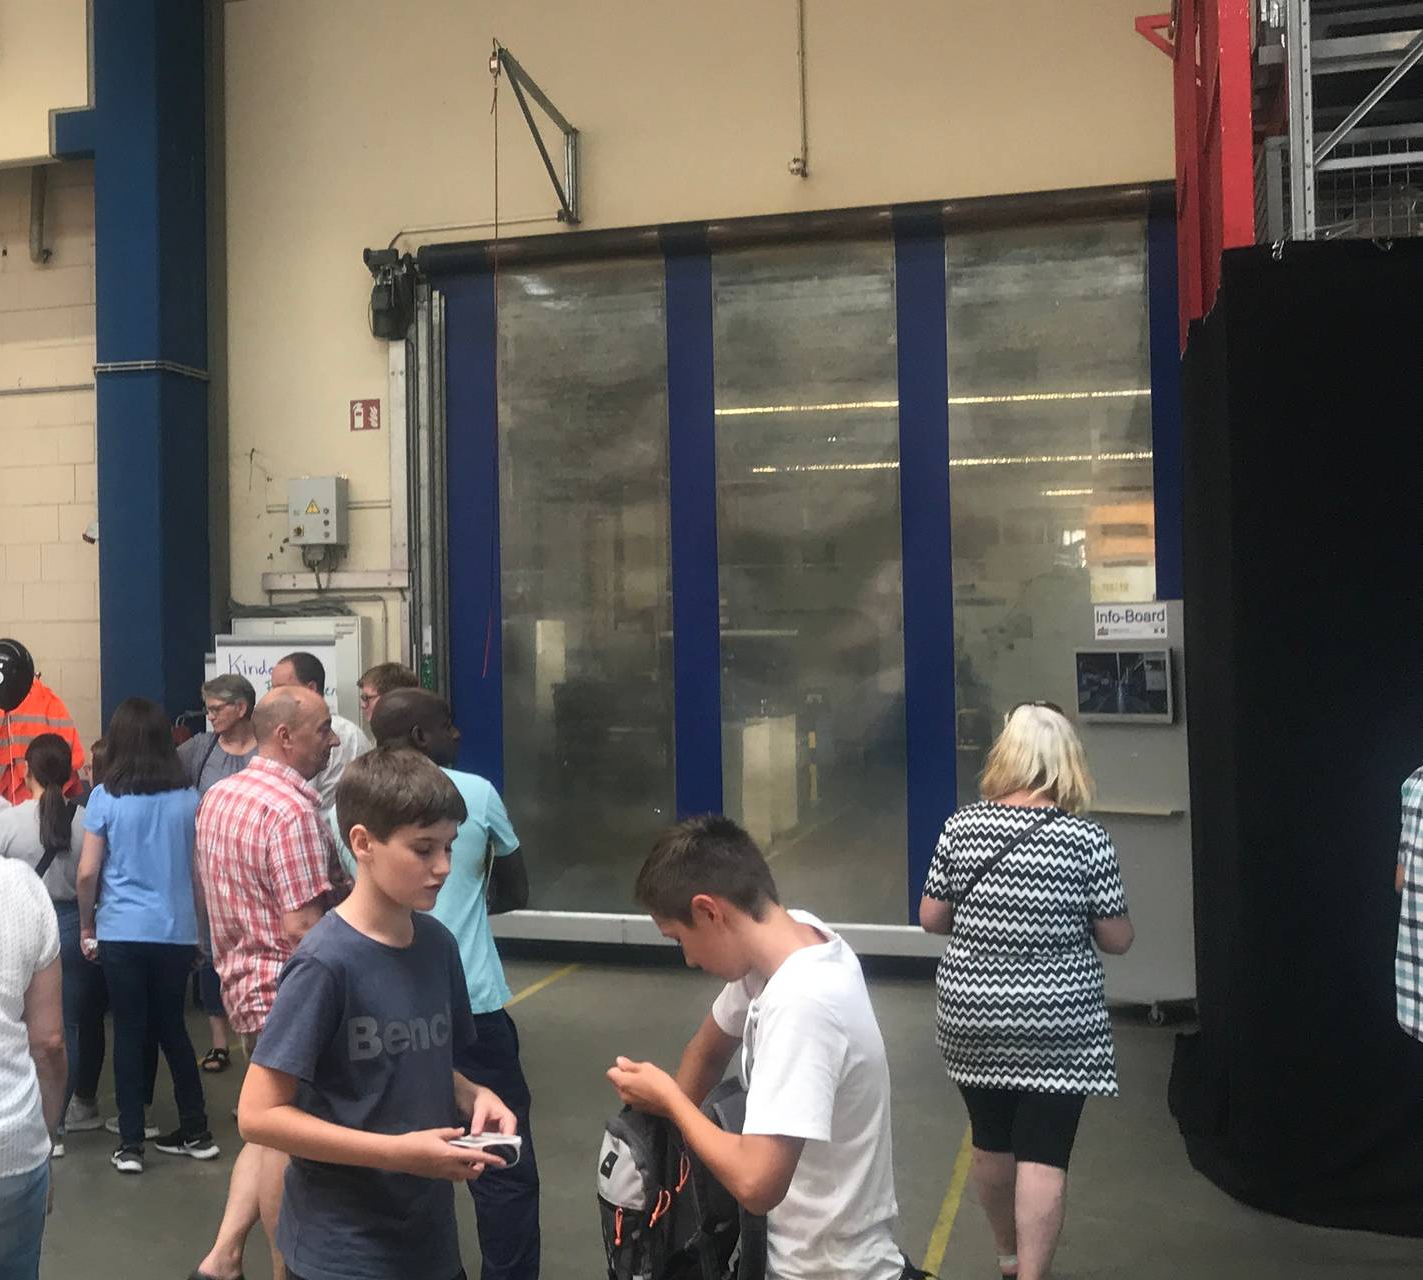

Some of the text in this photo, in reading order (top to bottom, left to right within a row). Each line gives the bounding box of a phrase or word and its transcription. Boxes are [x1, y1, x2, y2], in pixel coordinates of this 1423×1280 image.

[1096, 609, 1165, 623] Info-Board
[228, 653, 274, 676] Kind
[347, 1003, 451, 1061] Benc
